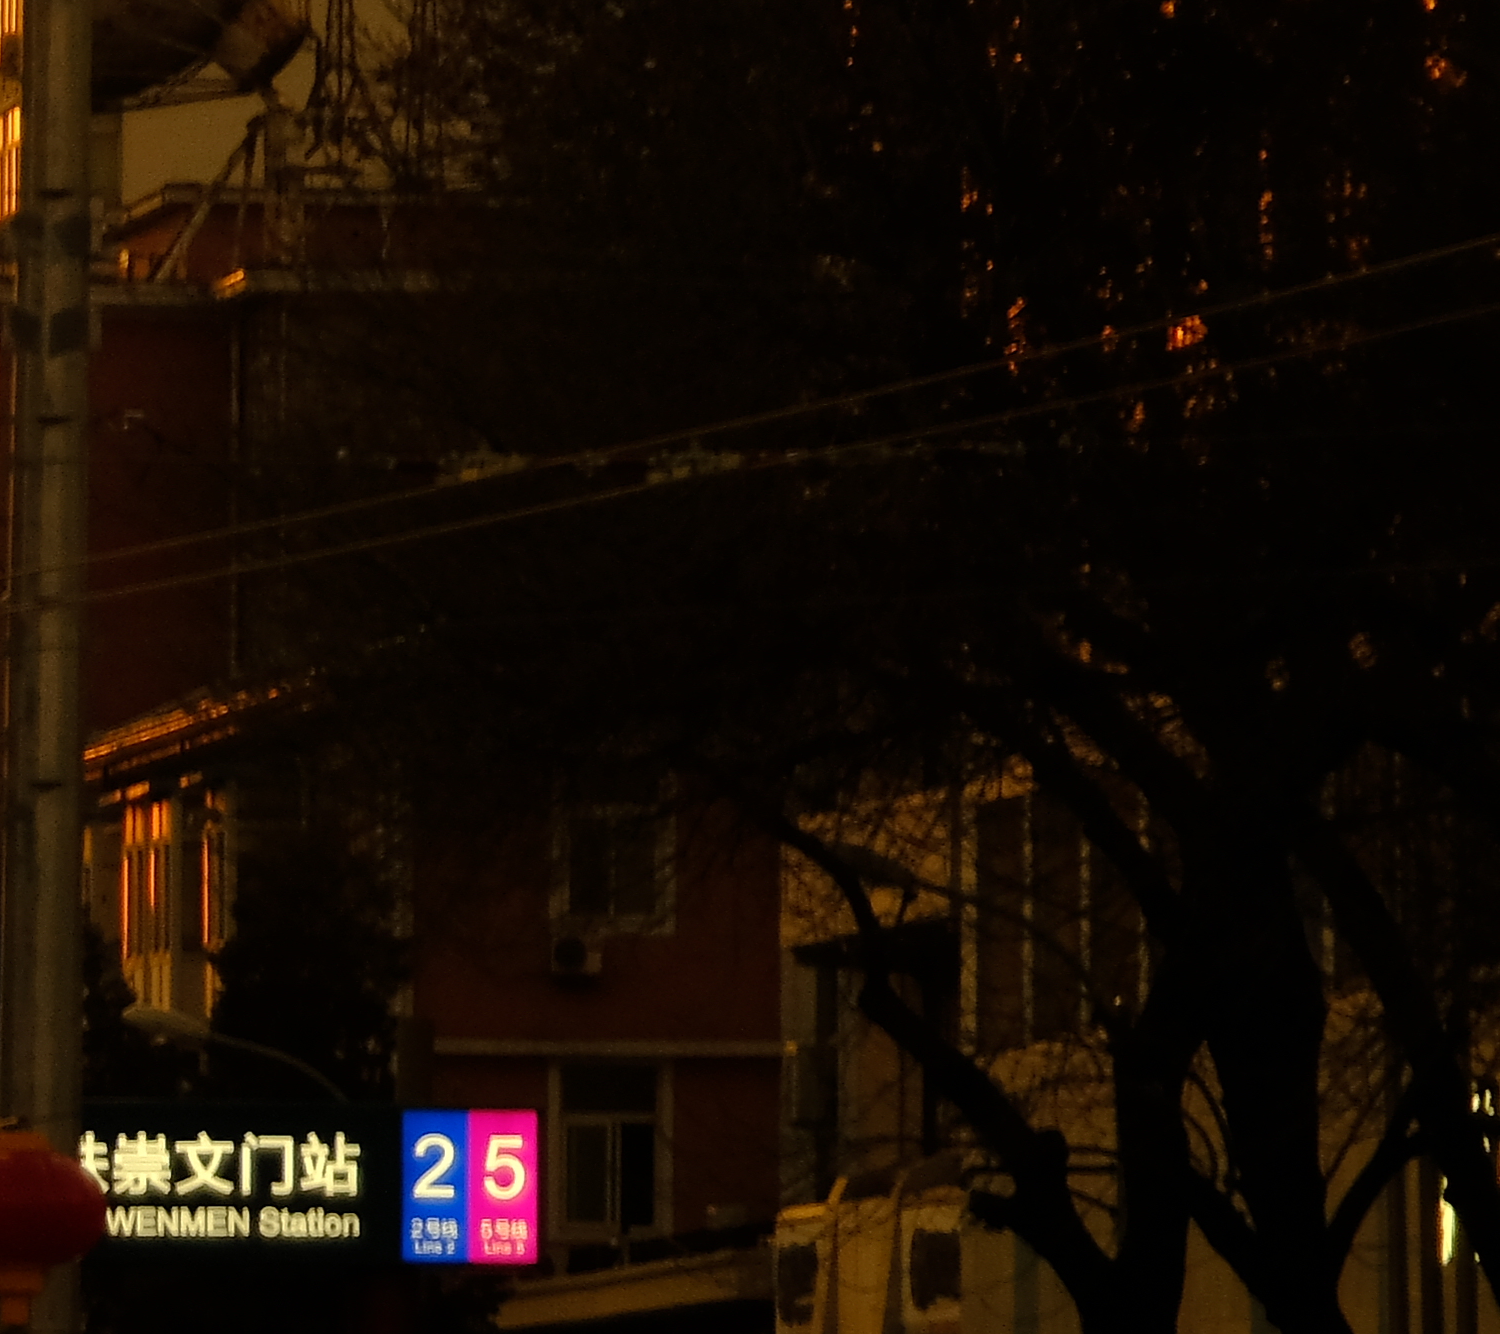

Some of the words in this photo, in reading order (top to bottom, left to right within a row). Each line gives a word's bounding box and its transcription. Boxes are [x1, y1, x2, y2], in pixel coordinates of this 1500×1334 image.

[414, 1132, 455, 1199] 2
[483, 1134, 526, 1201] 5
[258, 1205, 361, 1238] Station
